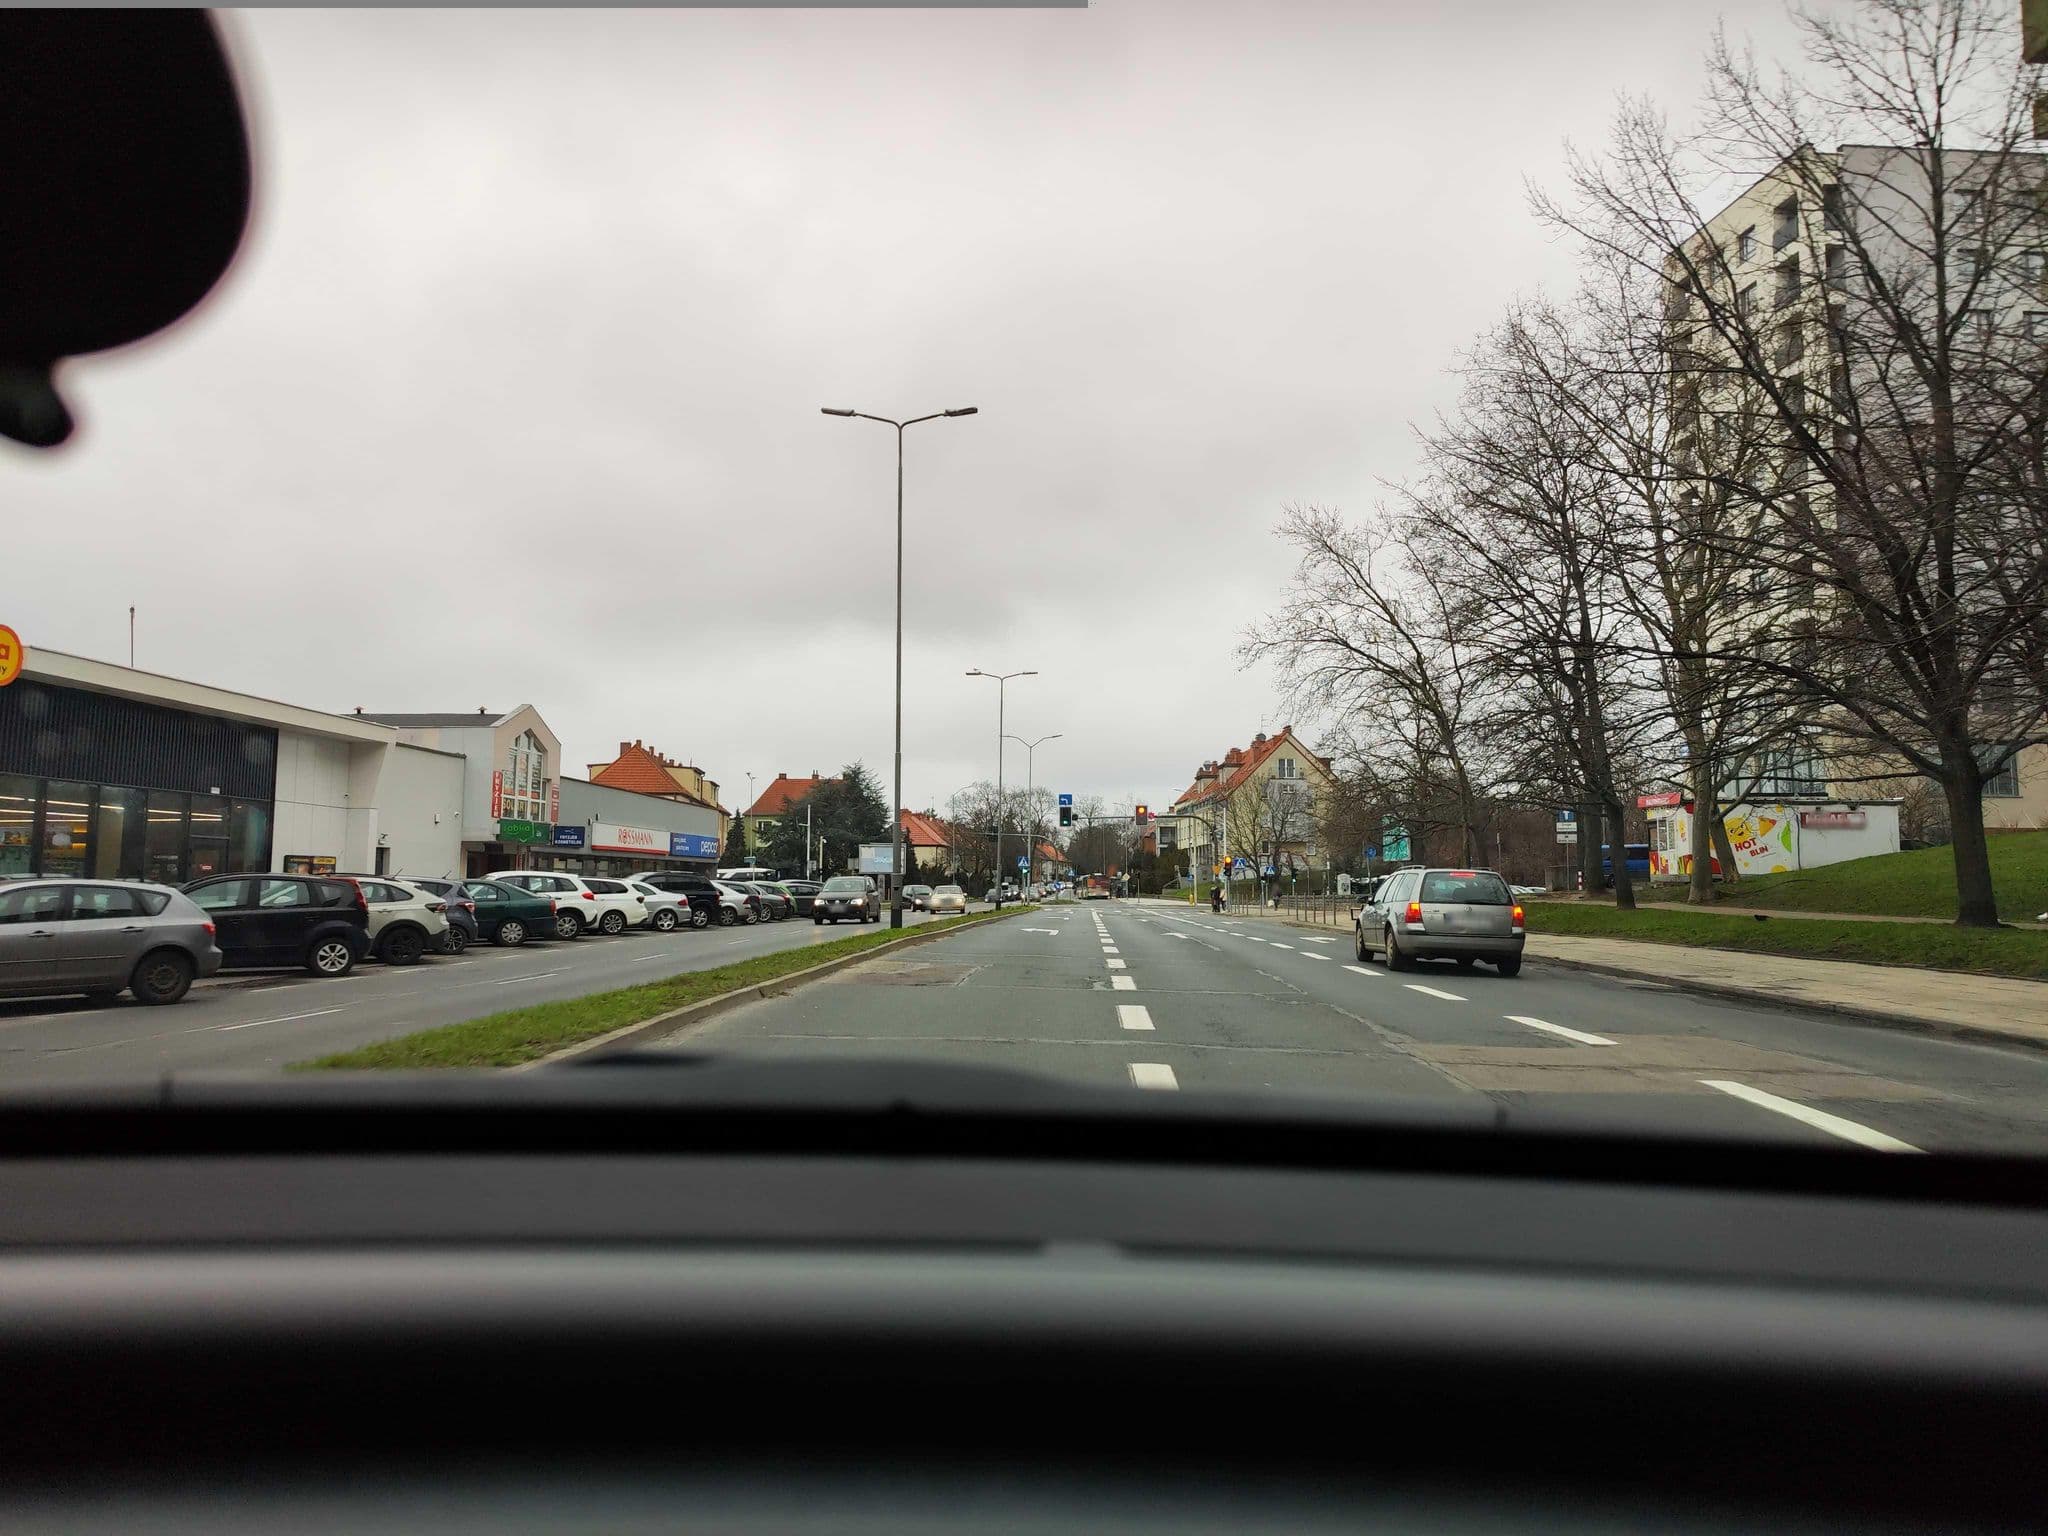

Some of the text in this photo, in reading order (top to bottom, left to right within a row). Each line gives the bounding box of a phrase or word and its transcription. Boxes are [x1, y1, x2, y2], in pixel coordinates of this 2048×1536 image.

[617, 828, 653, 845] ROSSMANN
[700, 840, 718, 855] pepco
[1734, 837, 1757, 852] HOT
[1749, 845, 1769, 857] BLIN
